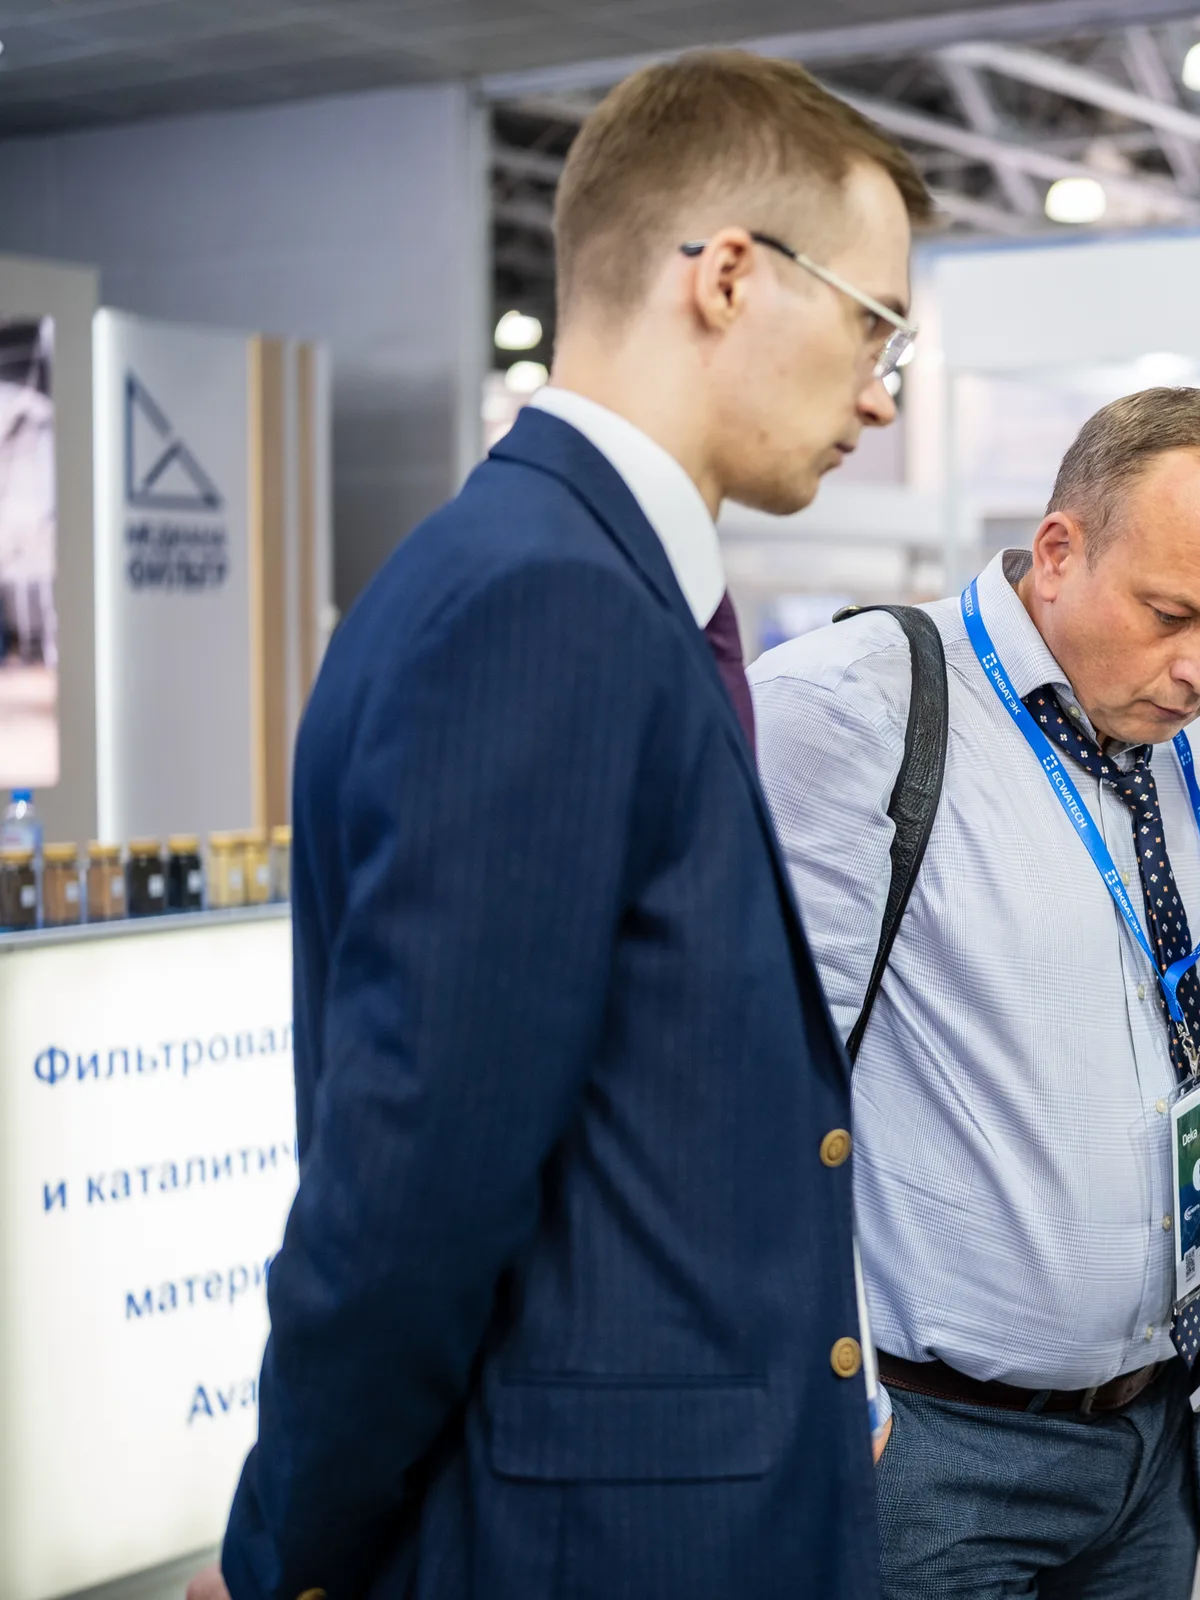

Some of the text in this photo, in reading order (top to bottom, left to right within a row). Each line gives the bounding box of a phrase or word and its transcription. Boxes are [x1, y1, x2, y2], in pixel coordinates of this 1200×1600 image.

[991, 668, 1022, 716] ЭКВАТЭК
[1051, 770, 1088, 829] ECWATECH
[1113, 884, 1141, 934] ЭКВАТЭК
[1182, 1127, 1198, 1147] Deka
[43, 1180, 68, 1214] и
